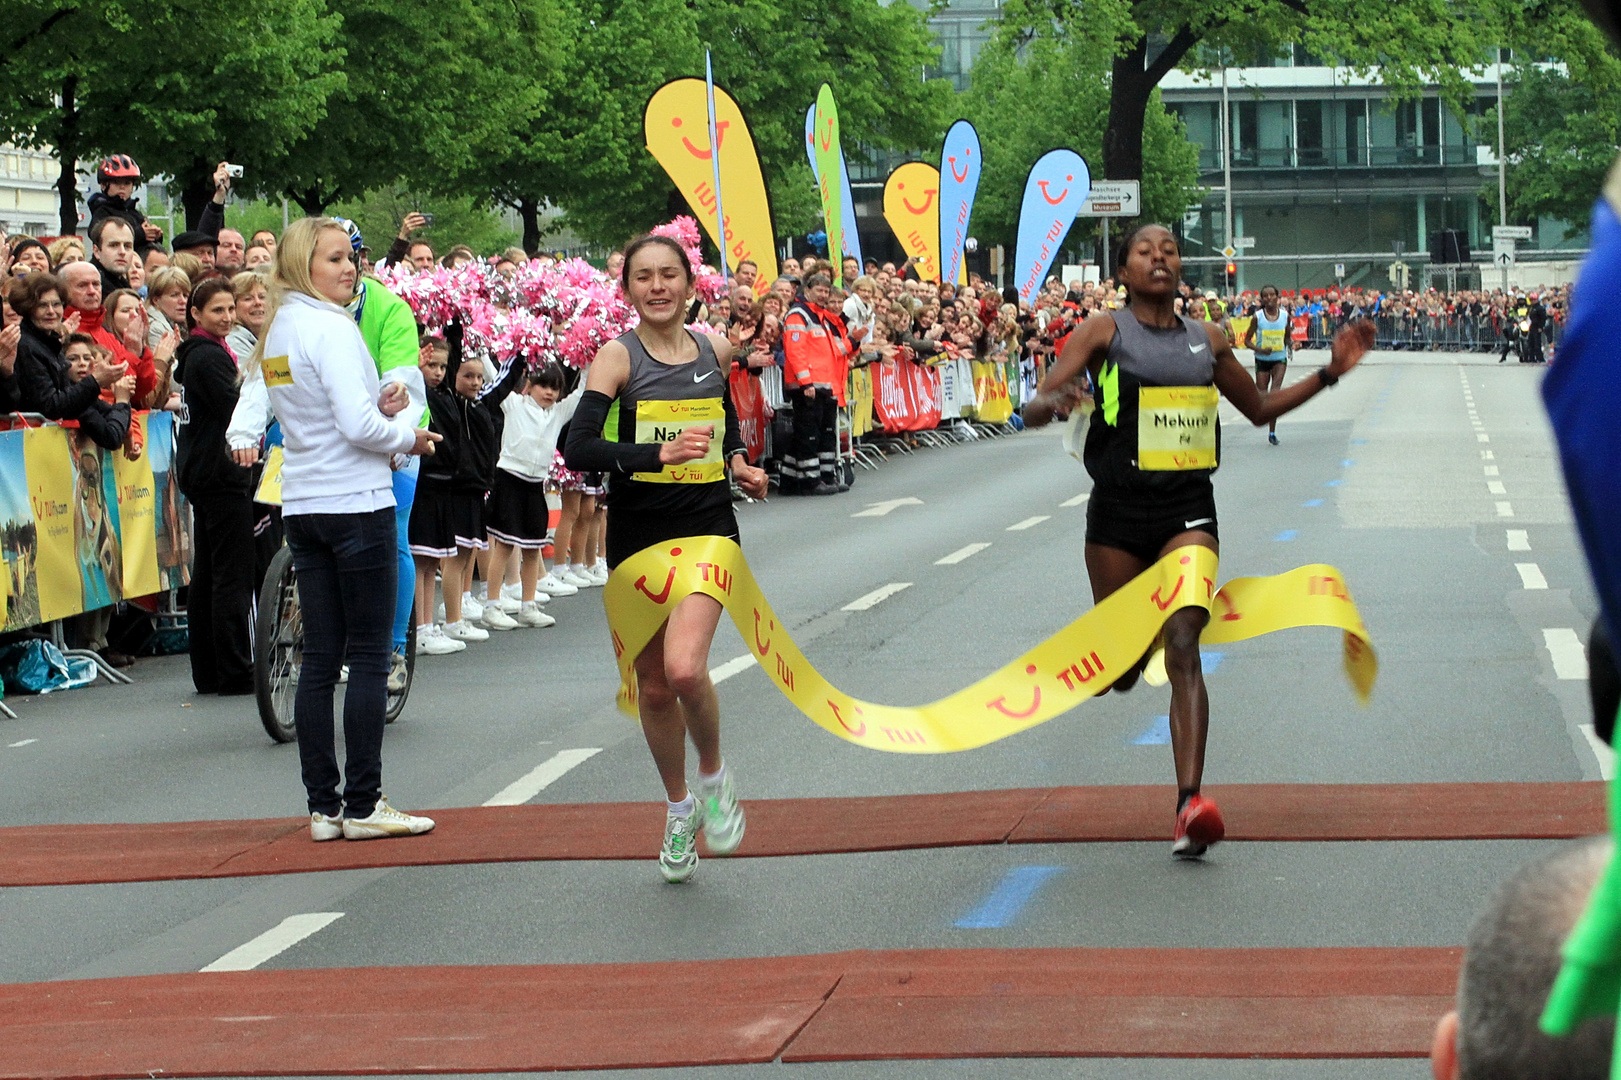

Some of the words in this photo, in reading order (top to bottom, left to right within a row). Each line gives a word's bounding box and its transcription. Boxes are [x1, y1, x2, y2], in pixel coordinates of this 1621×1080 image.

[957, 200, 969, 226] TUI
[955, 228, 963, 246] of
[1018, 265, 1043, 299] World
[1040, 243, 1050, 261] of
[1046, 219, 1064, 244] TUI
[696, 562, 732, 597] TUI
[776, 652, 794, 692] TUI
[1056, 650, 1106, 691] TUI
[880, 726, 928, 745] TUI
